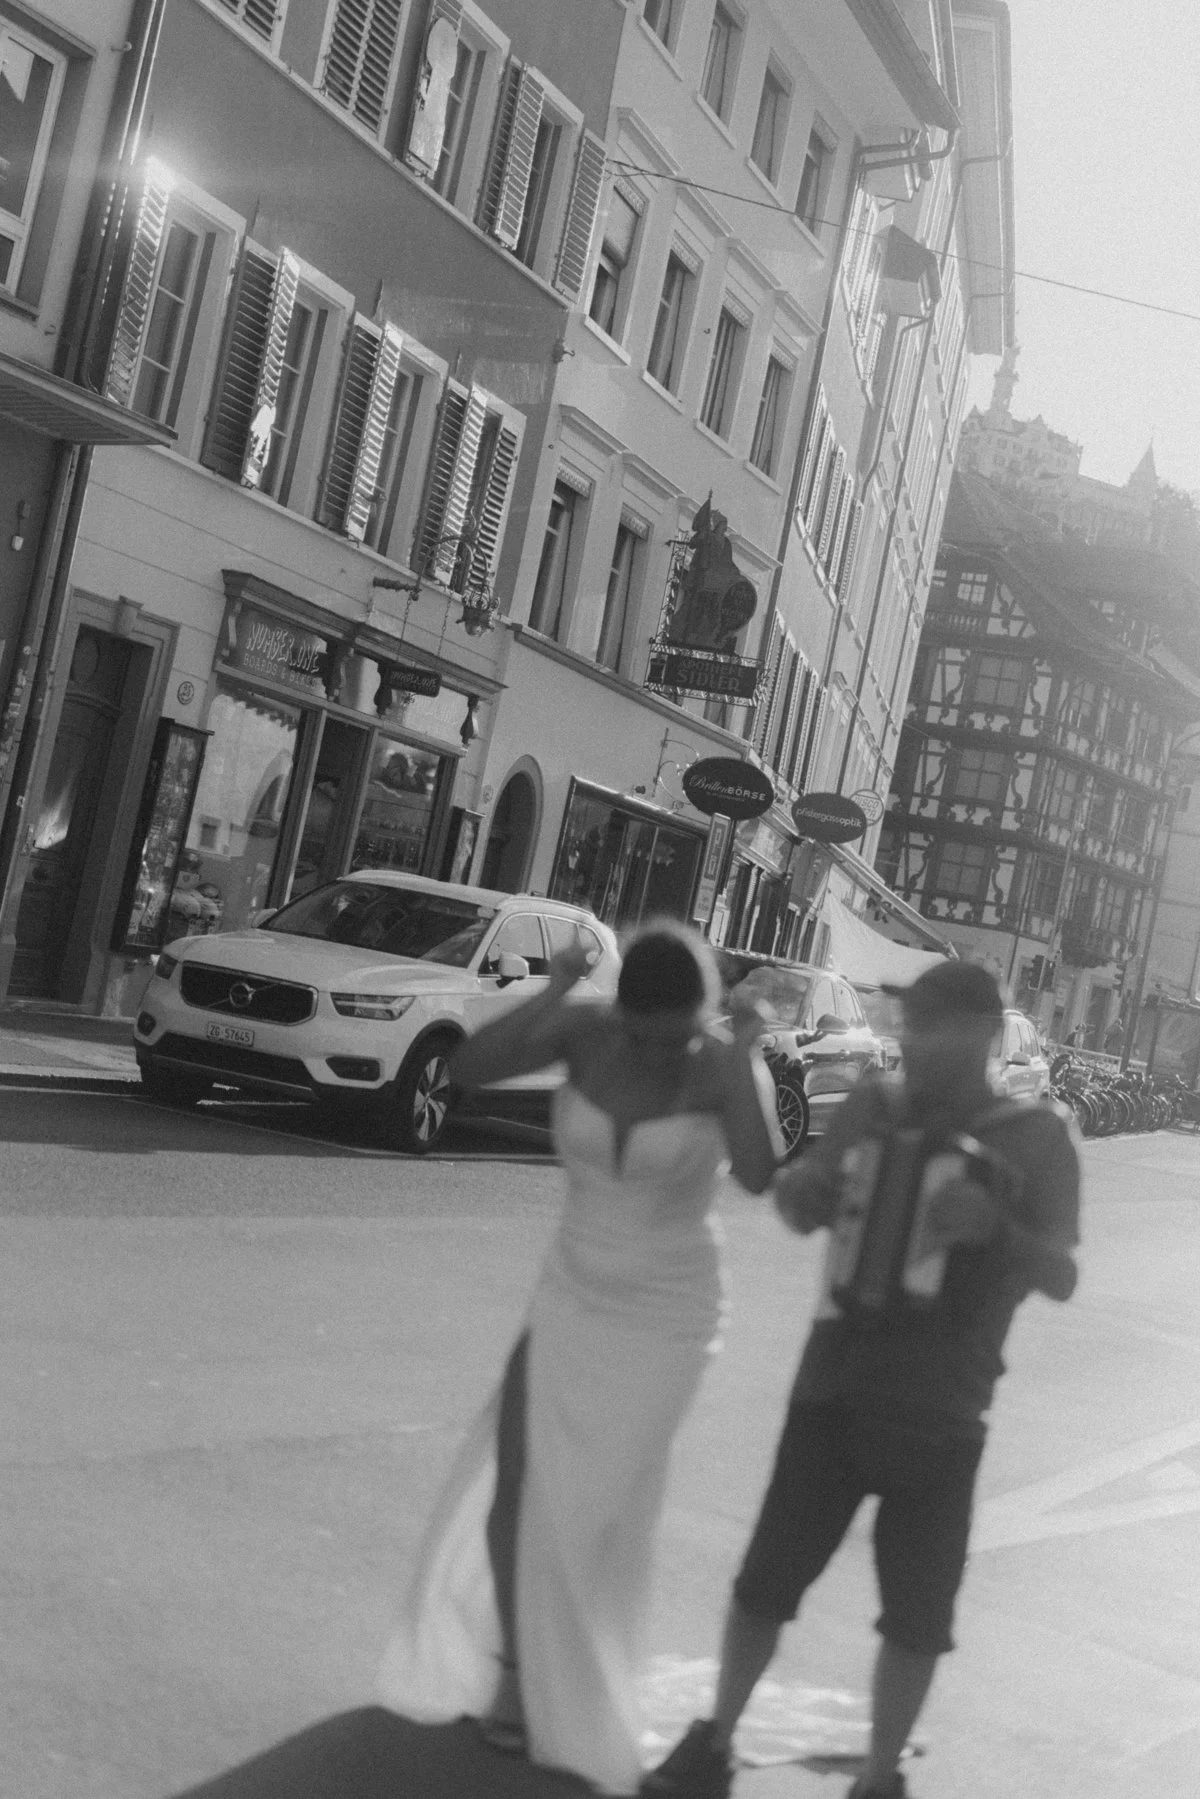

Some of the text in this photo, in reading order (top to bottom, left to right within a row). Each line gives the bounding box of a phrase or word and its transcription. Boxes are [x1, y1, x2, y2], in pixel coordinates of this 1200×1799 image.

[243, 653, 278, 677] BOARDS
[677, 669, 740, 692] SIDLER
[210, 1025, 250, 1042] ZG 57645
